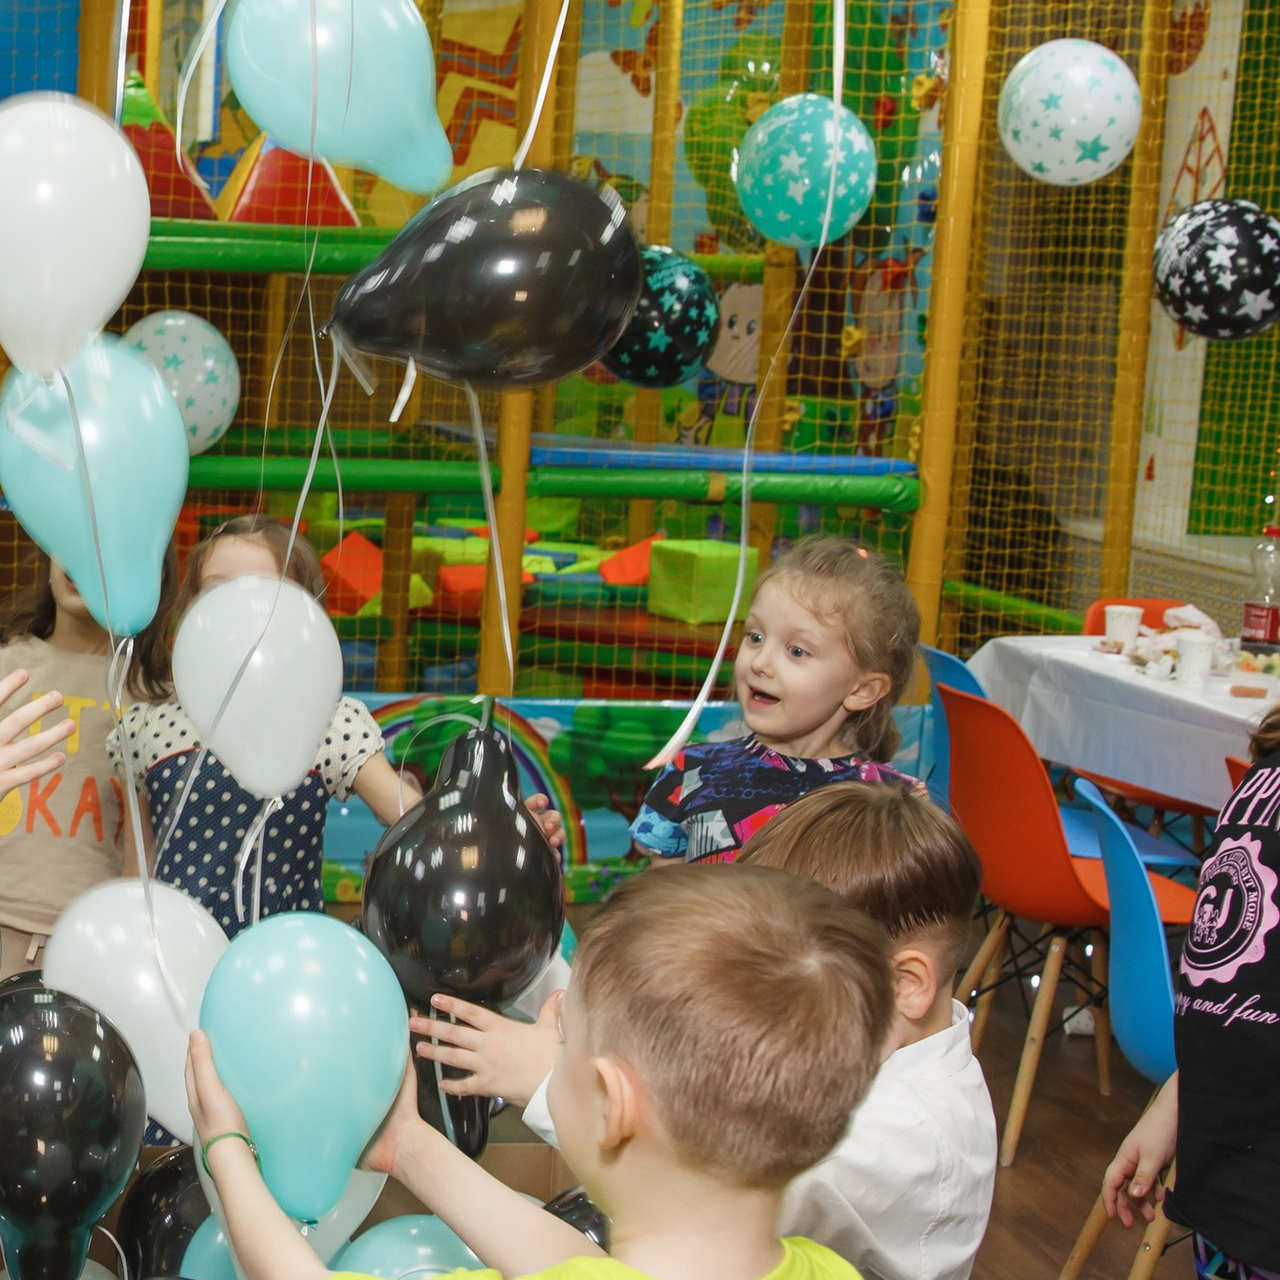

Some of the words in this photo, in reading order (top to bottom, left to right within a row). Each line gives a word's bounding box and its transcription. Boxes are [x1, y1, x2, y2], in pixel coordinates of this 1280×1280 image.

[1241, 866, 1256, 890] BIT
[1242, 892, 1258, 932] MORE
[1193, 992, 1238, 1015] and
[1223, 994, 1280, 1027] fun
